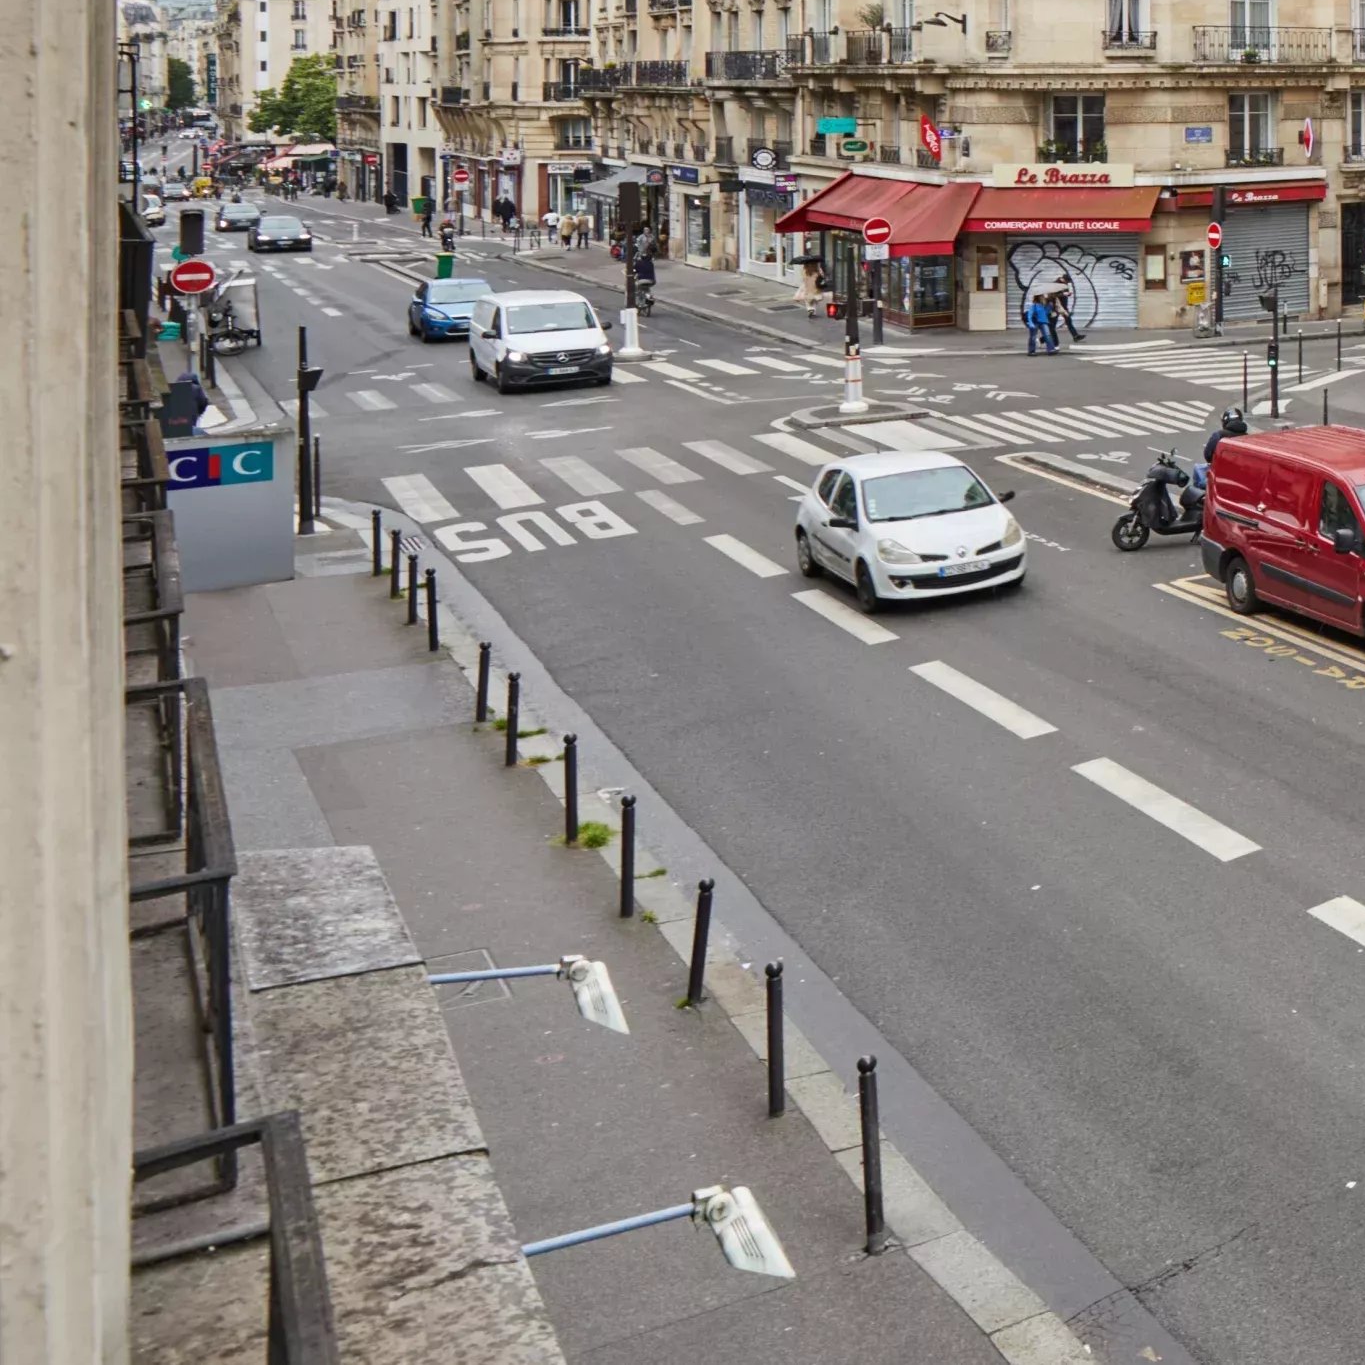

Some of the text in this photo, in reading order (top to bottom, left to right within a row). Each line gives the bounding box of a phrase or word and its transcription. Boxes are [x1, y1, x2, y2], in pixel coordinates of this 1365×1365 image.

[923, 123, 939, 152] TABAC
[1014, 168, 1111, 184] Le Brazza
[984, 220, 1120, 230] COMMERÇANT D'UTILITÉ LOCALE
[168, 450, 261, 482] CIC
[433, 500, 639, 562] BUS
